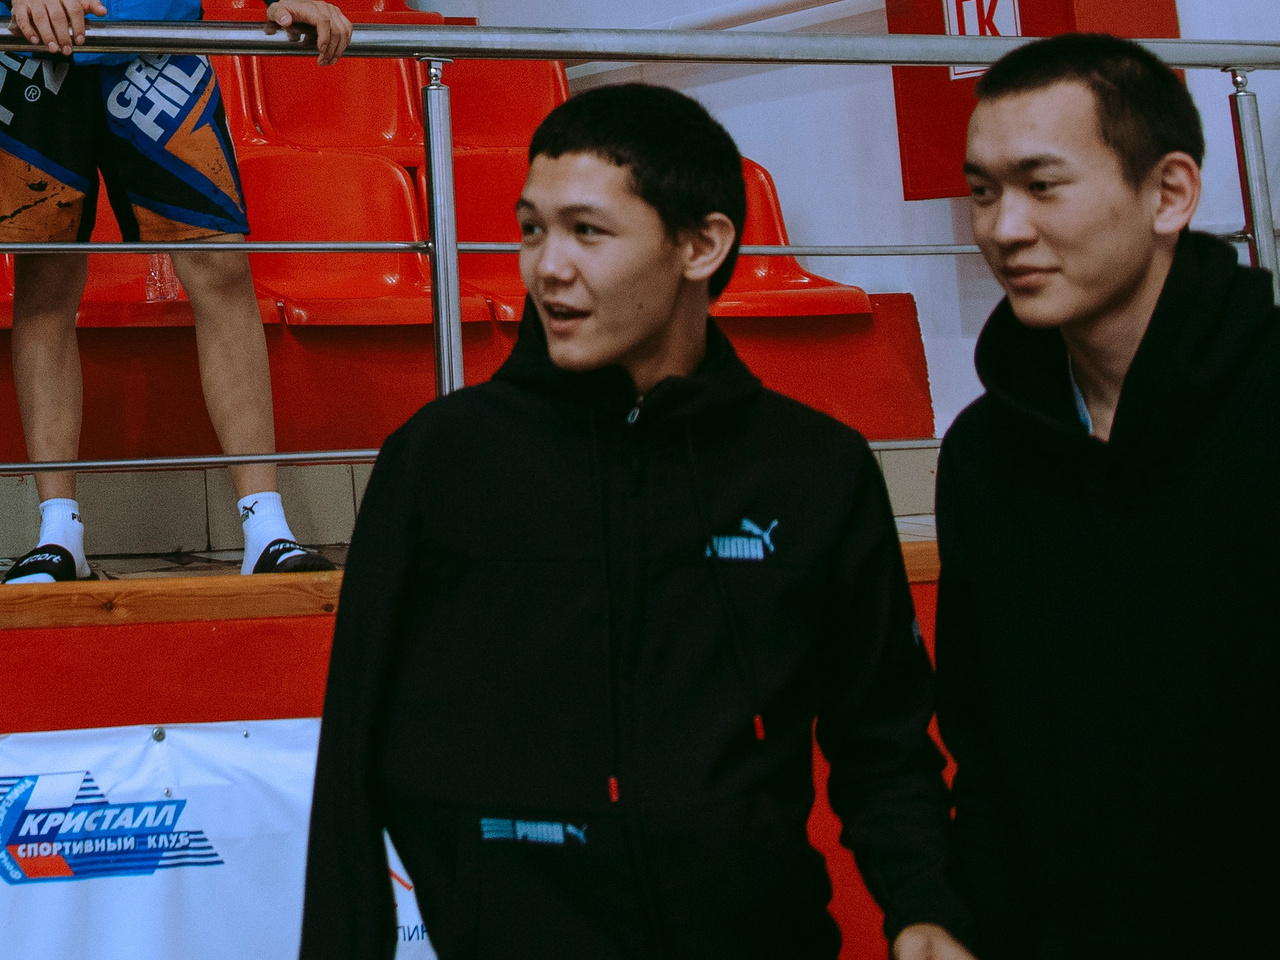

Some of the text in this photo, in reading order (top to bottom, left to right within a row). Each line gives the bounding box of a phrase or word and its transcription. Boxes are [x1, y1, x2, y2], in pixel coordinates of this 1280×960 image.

[19, 804, 177, 837] КРИСТАЛЛ
[17, 832, 192, 859] СПОРТИВНЫЙ КЛУБ
